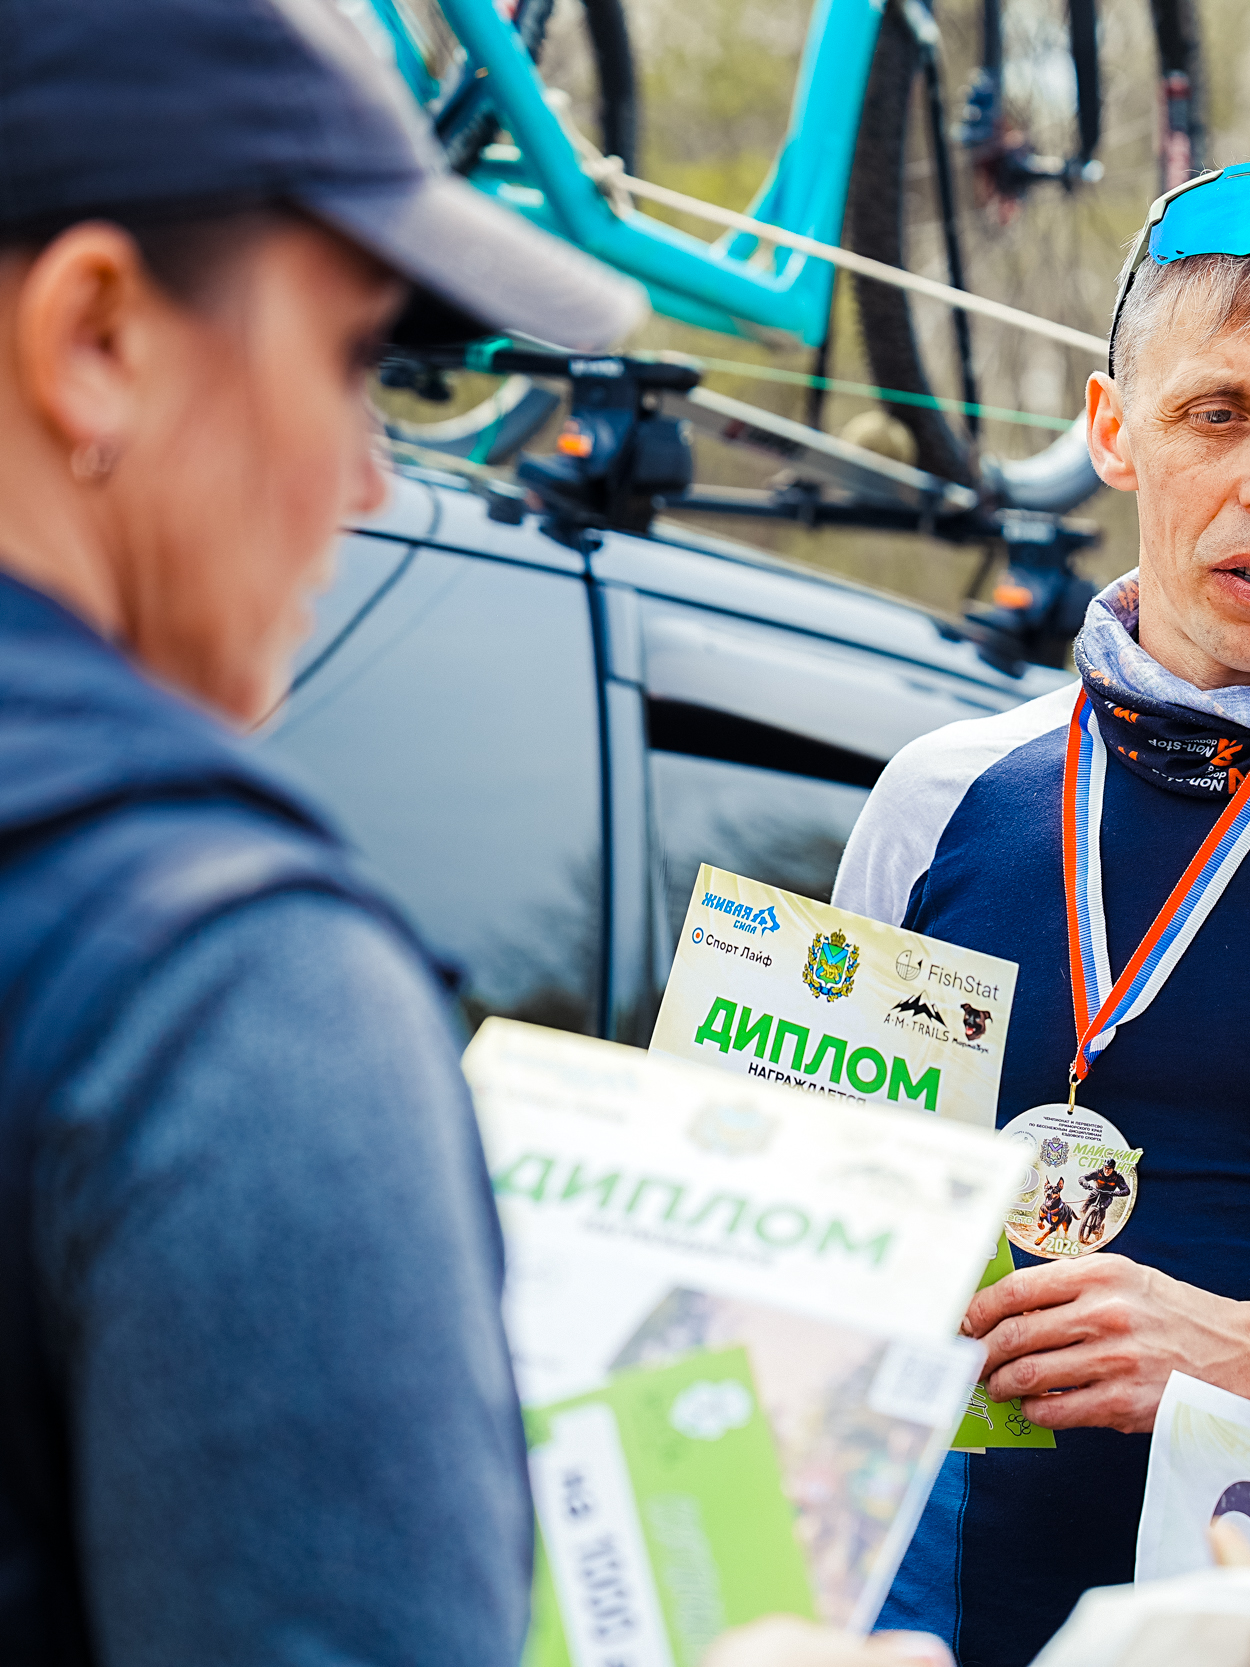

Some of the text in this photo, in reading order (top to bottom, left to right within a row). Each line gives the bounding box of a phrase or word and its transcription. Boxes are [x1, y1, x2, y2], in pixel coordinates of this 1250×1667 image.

[701, 892, 754, 922] ЖИВАЯ
[733, 919, 758, 936] СИЛА
[705, 934, 773, 968] Спорт Лайф
[927, 963, 1000, 1002] FishStat
[694, 996, 941, 1112] ДИПЛОМ
[1072, 1143, 1143, 1163] МАЙСКИЙ
[1046, 1237, 1080, 1255] 2026
